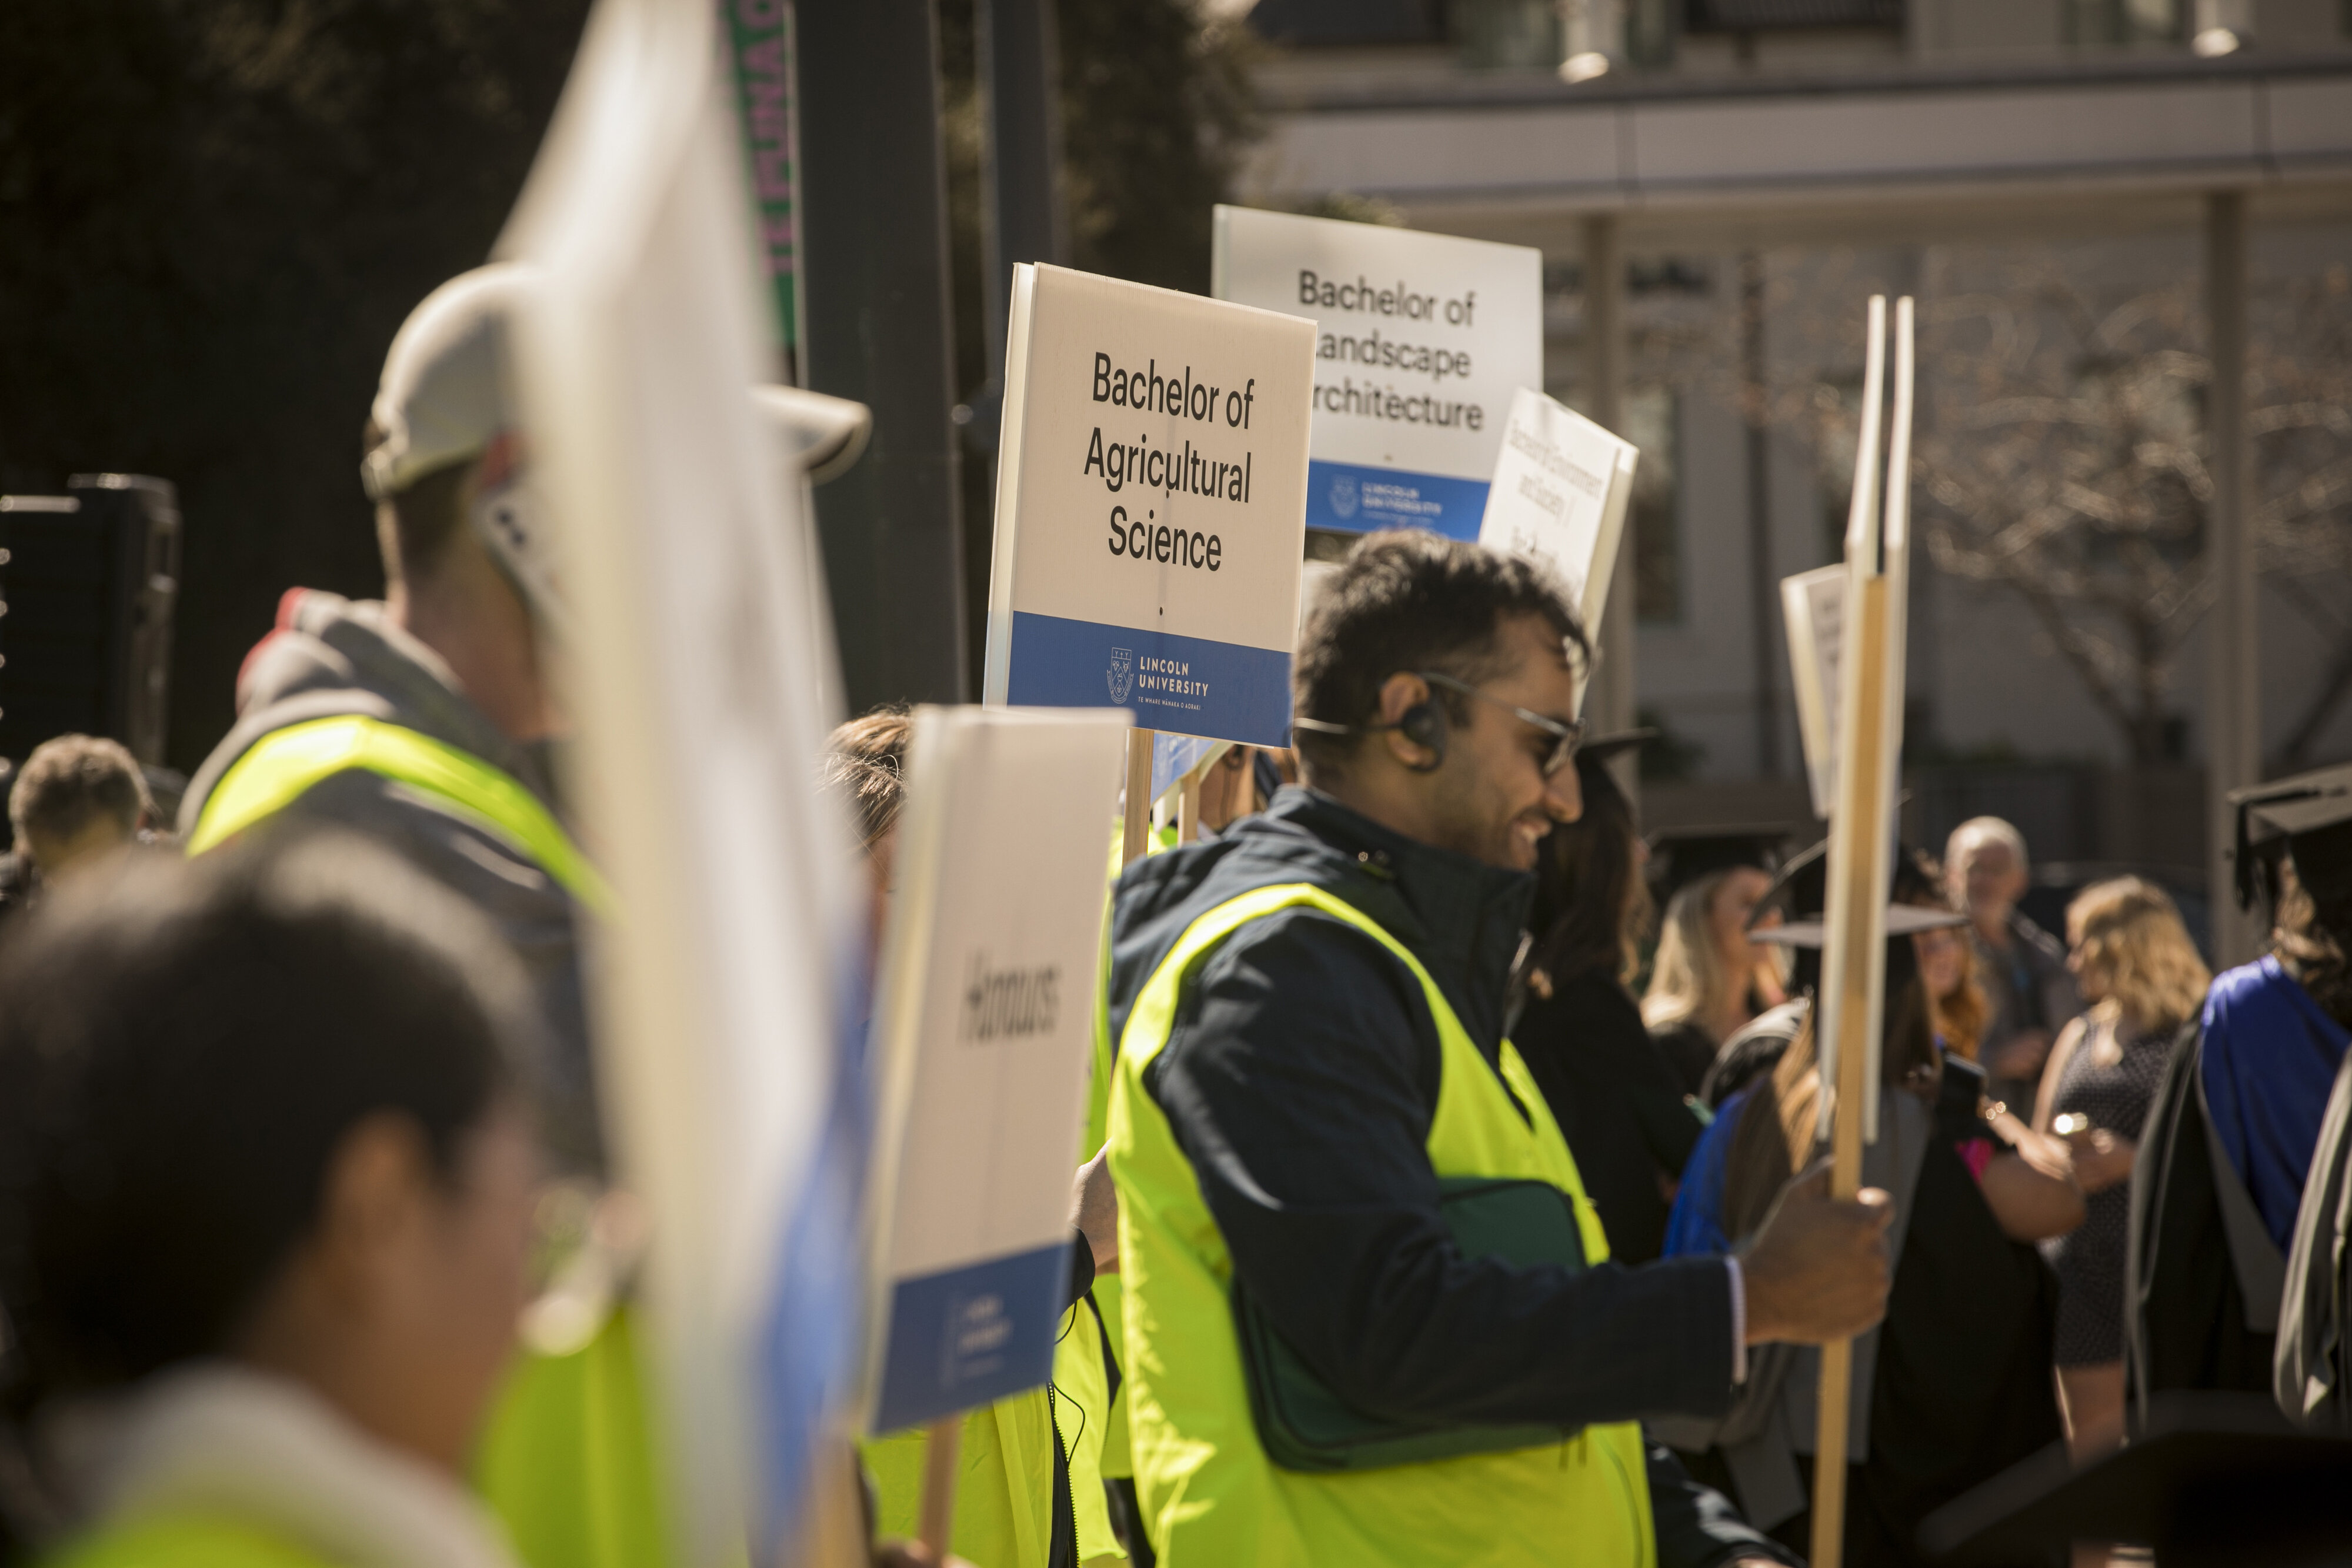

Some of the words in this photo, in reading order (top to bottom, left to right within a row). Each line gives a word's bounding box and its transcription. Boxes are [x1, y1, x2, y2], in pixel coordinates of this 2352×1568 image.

[1299, 269, 1437, 321] Bachelor
[1444, 291, 1476, 326] of
[1316, 328, 1472, 381] andscape
[1092, 351, 1220, 423] Bachelor
[1226, 378, 1255, 430] of
[1312, 376, 1484, 431] rchitecture
[1083, 426, 1252, 503] Agricultural
[1108, 505, 1222, 572] Science
[1139, 656, 1189, 676] LINCOLN
[1139, 674, 1209, 697] UNIVERSITY
[1145, 697, 1160, 705] WHARE
